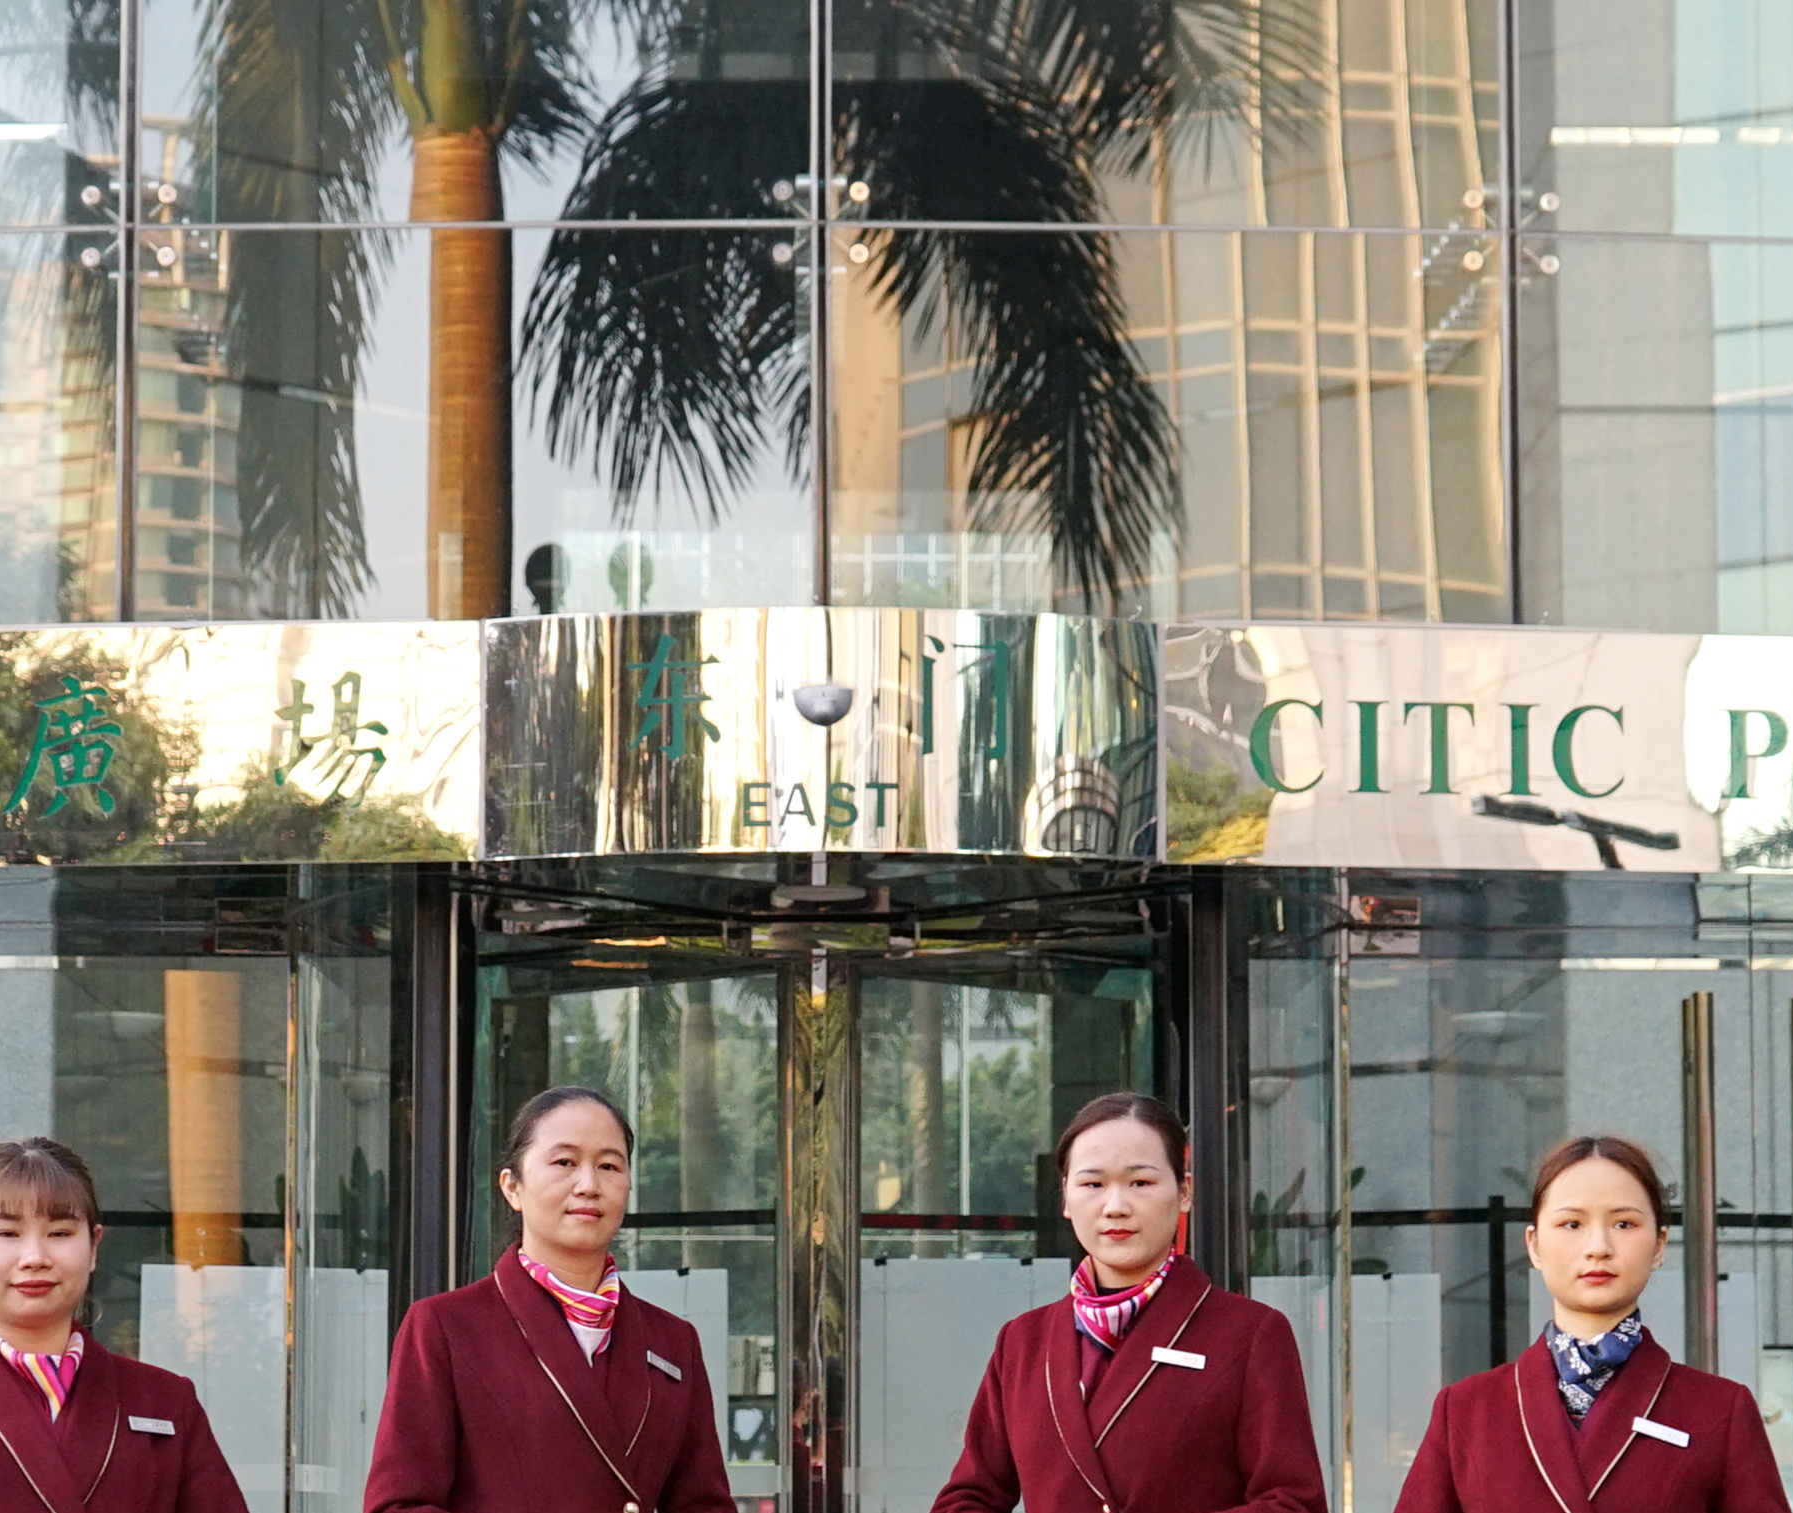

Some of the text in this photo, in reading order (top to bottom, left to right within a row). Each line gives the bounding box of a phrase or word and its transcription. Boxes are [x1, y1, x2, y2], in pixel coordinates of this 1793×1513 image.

[627, 633, 1011, 761] 东门
[1249, 698, 1627, 799] CITIC
[742, 782, 900, 828] EAST
